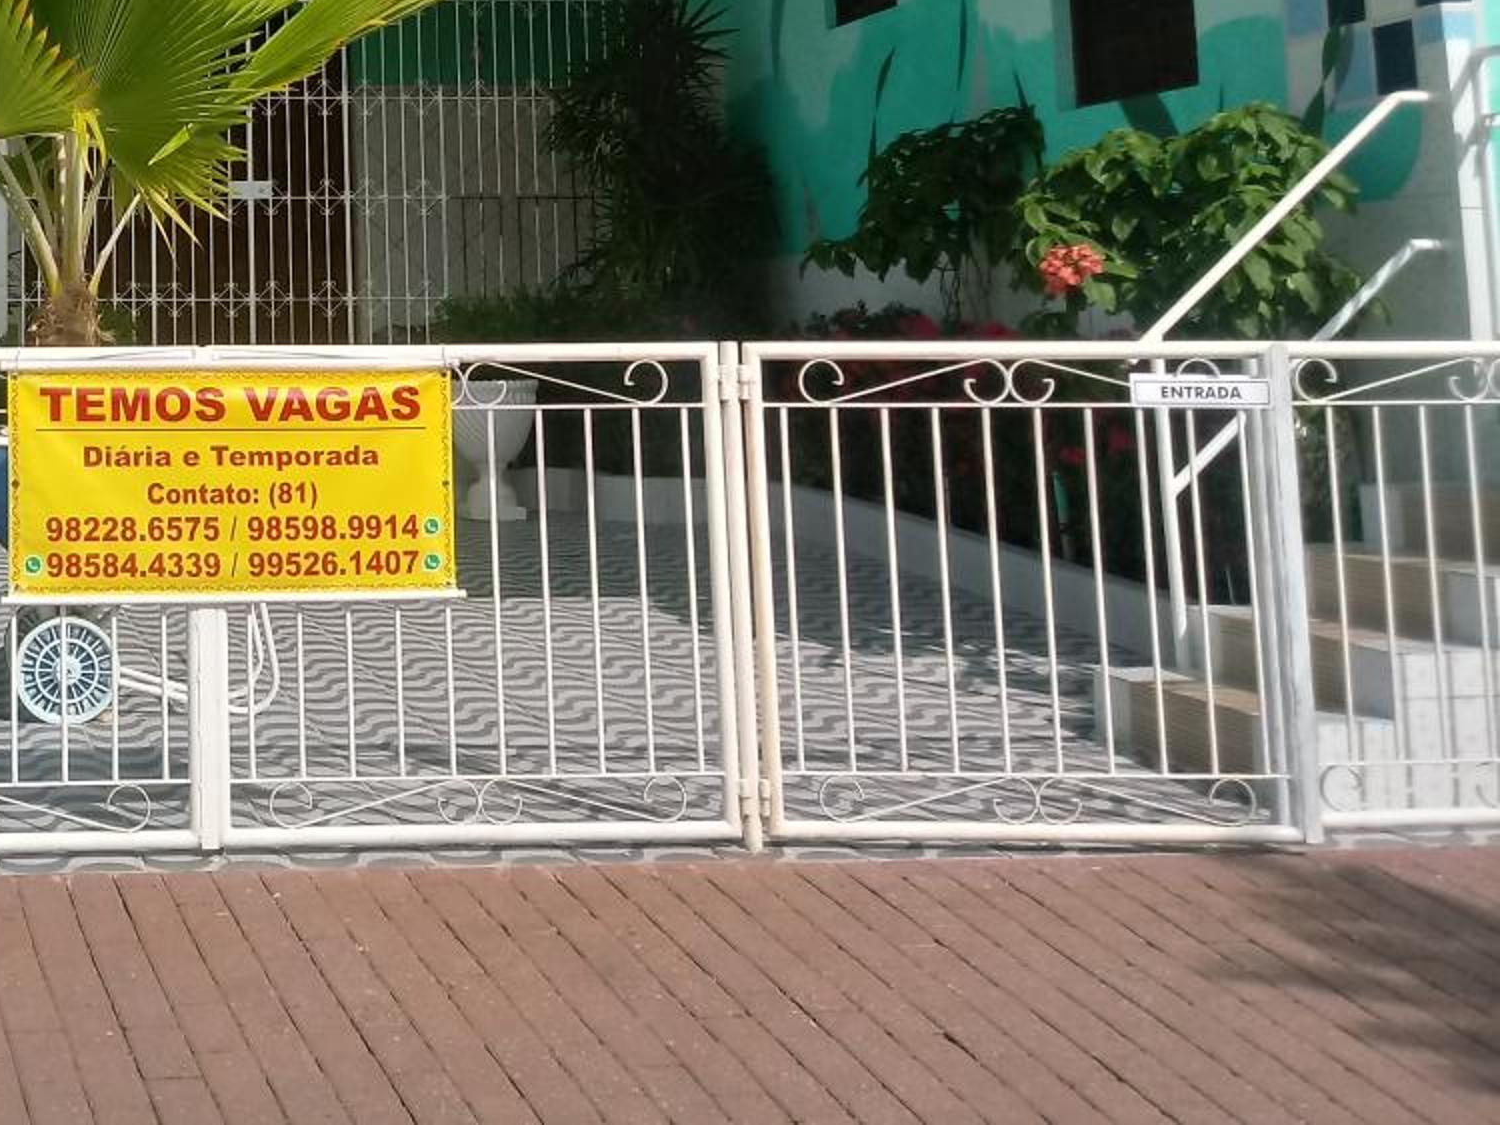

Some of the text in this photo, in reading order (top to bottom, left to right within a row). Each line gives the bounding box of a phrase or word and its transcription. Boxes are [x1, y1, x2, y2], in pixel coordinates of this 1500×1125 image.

[40, 385, 422, 423] TEMOS VAGAS
[1160, 385, 1242, 400] ENTRADA
[83, 445, 380, 472] Diária e Temporada
[147, 482, 318, 509] Contato: (81)
[45, 514, 419, 543] 98228.6575 / 98598.9914
[46, 551, 420, 578] 98584.4339 / 99526.1407
